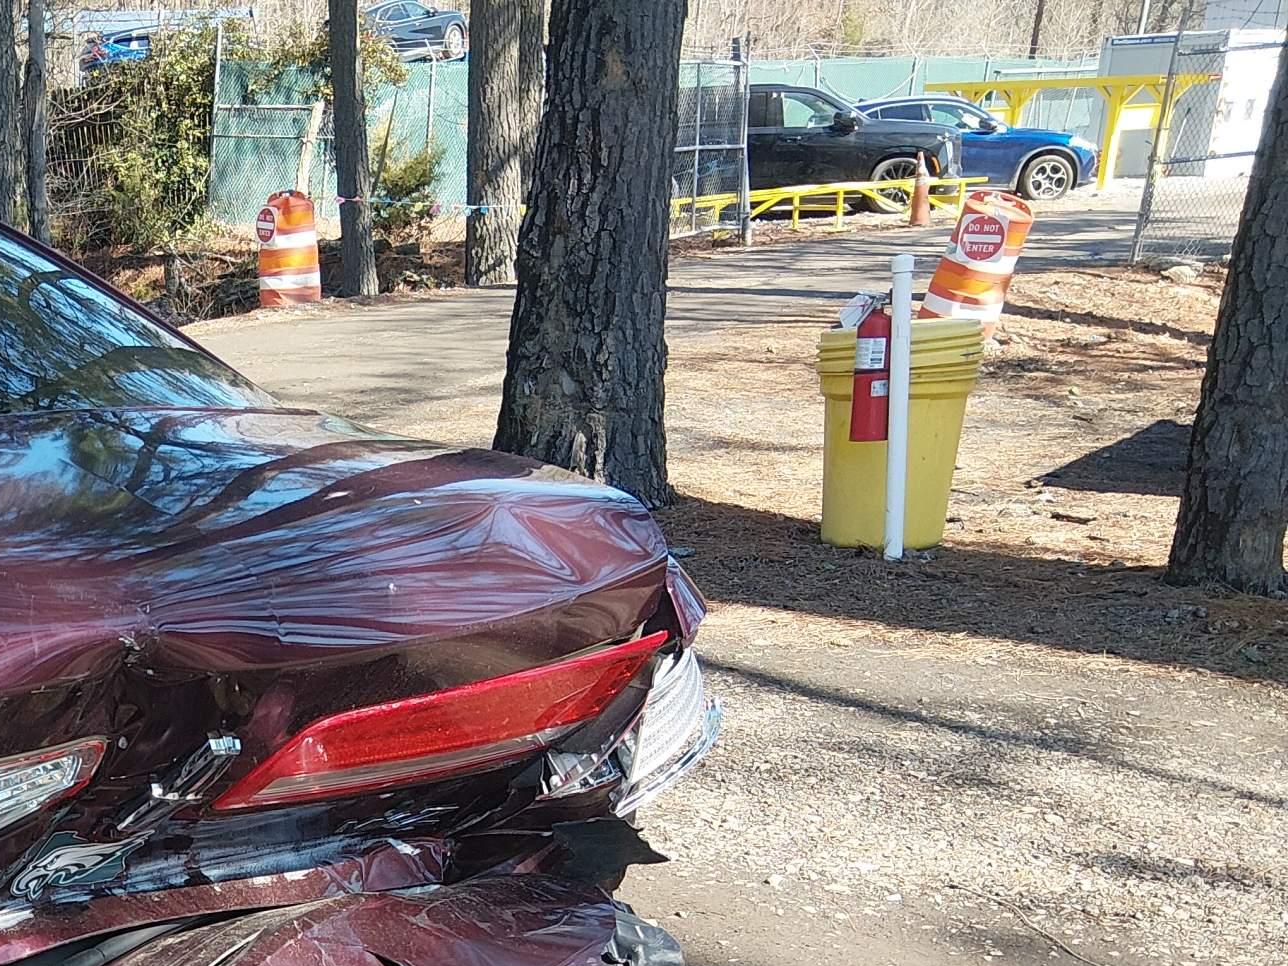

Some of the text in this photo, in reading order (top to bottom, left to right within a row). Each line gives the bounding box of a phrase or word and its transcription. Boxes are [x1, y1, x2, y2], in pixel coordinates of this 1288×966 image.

[968, 223, 1000, 232] DO NOT
[966, 244, 994, 253] ENTER
